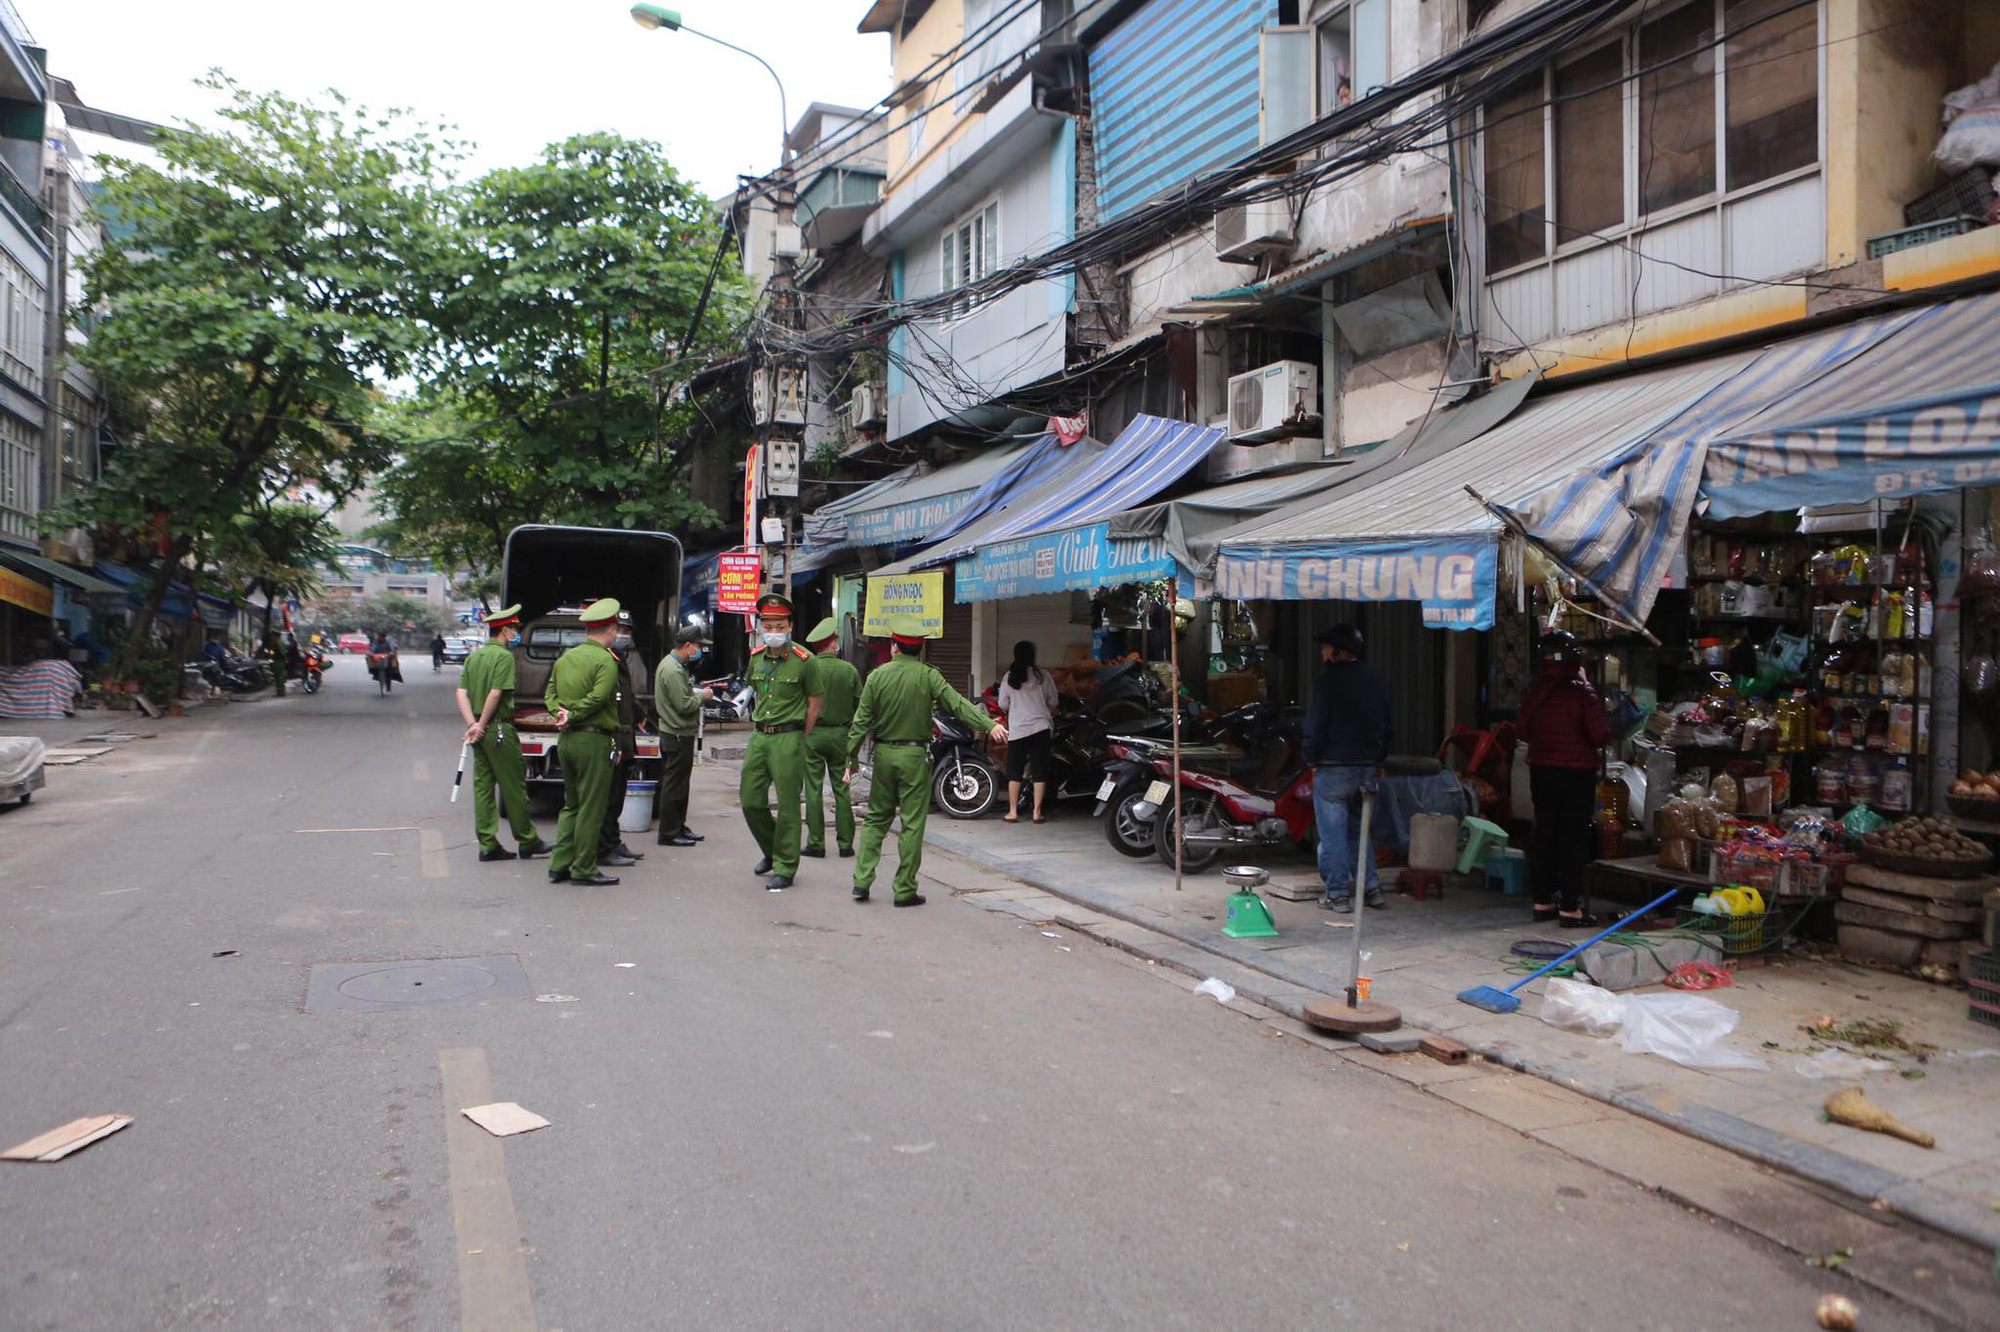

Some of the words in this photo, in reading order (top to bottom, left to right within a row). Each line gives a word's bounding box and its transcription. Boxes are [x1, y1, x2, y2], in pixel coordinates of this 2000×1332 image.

[894, 508, 916, 531] MAI
[920, 501, 950, 527] THOA
[1057, 528, 1100, 575] Vinh
[721, 572, 741, 585] CƠM
[1297, 554, 1476, 600] CHUNG
[903, 582, 923, 603] NGỌC
